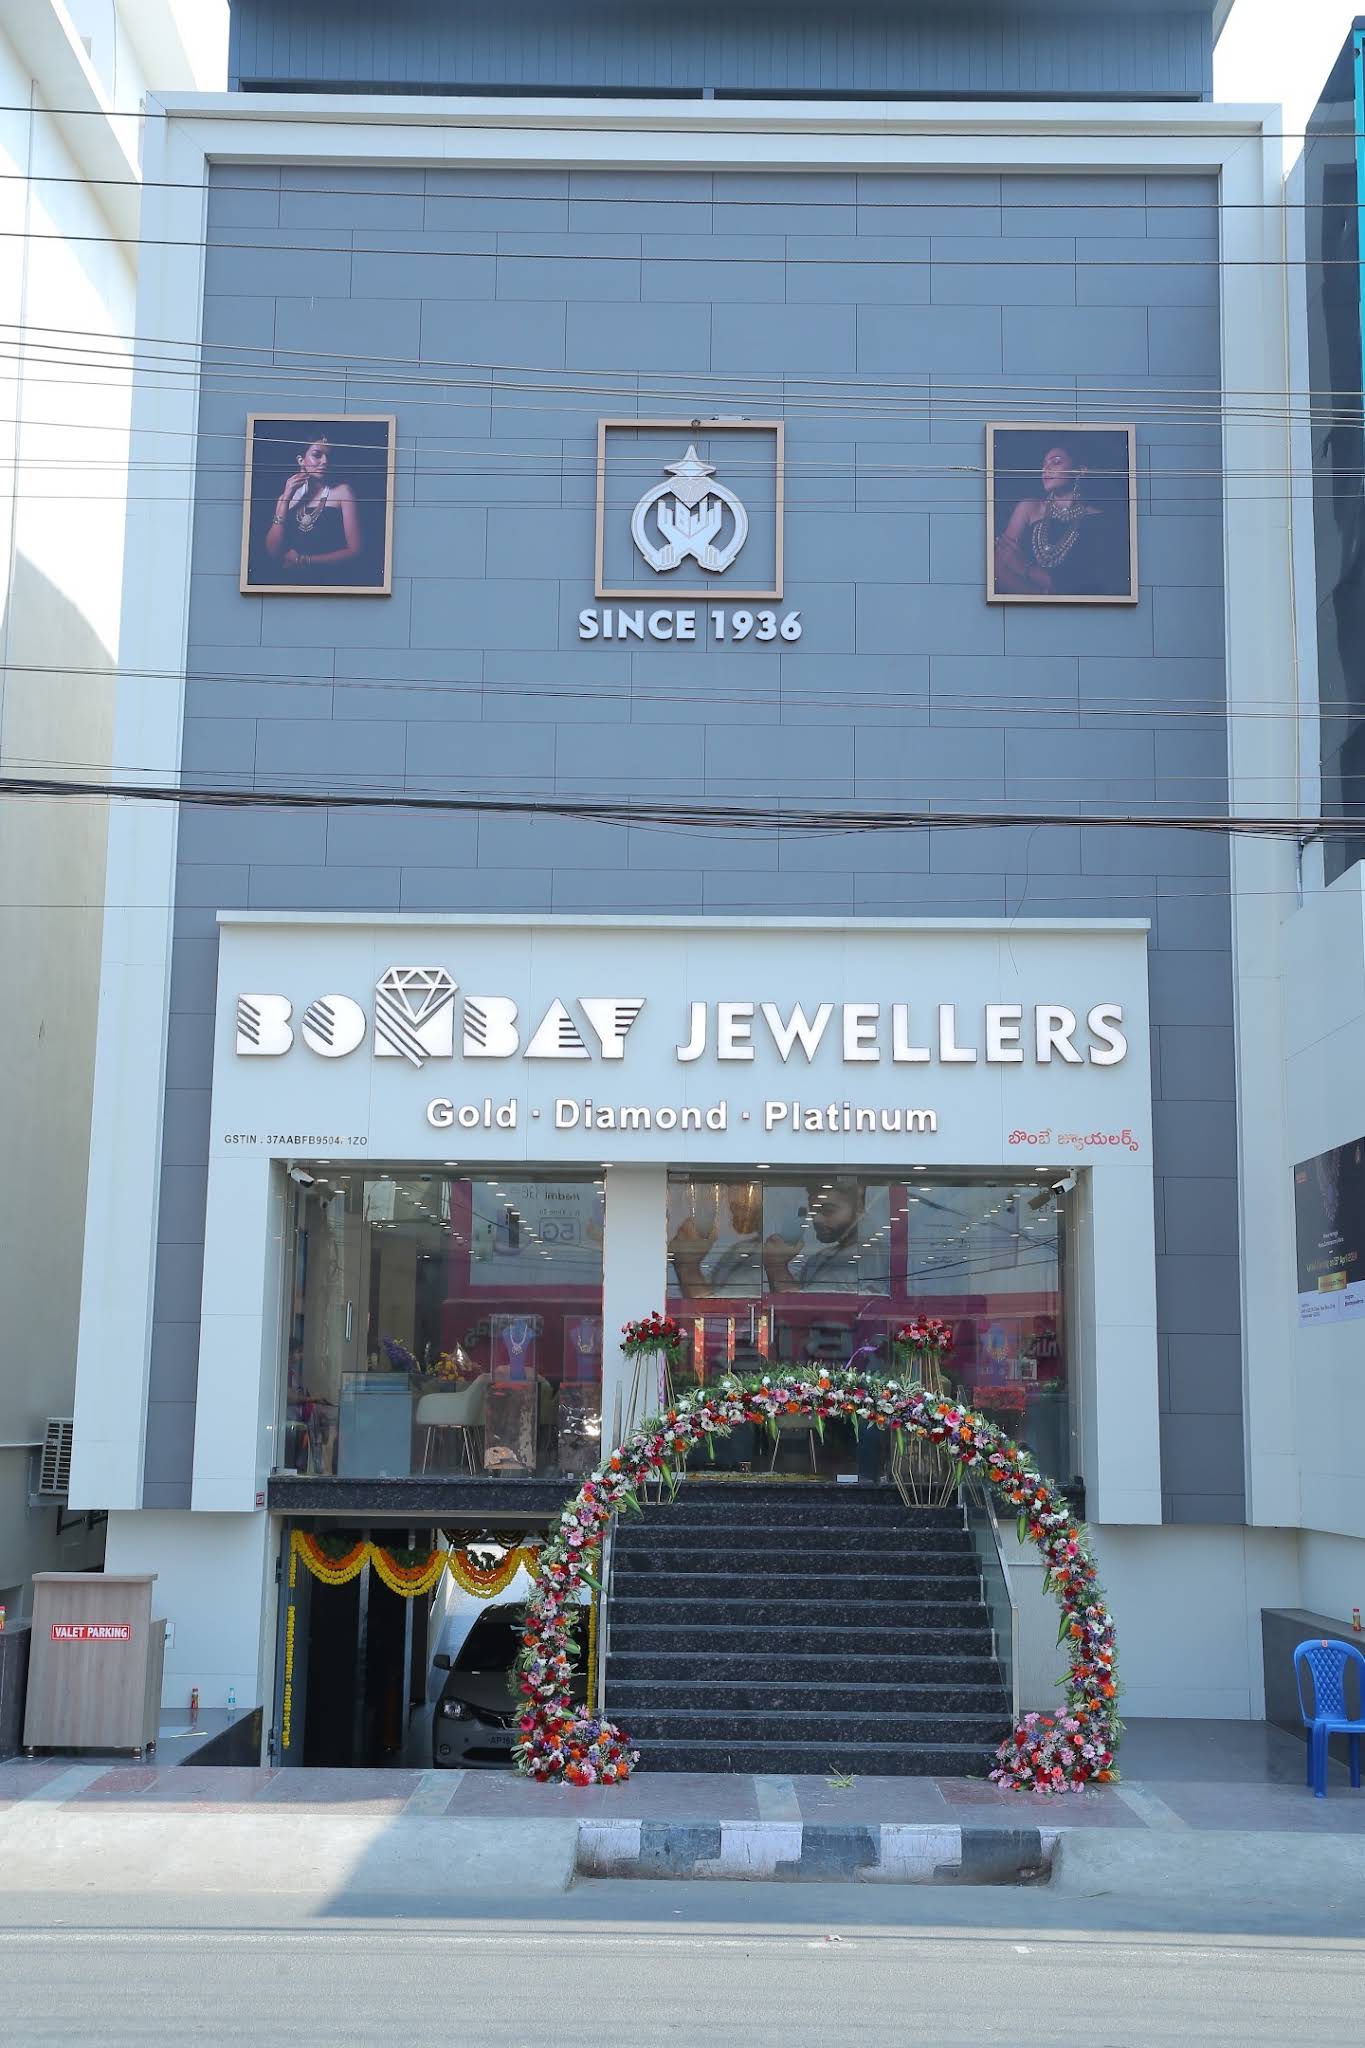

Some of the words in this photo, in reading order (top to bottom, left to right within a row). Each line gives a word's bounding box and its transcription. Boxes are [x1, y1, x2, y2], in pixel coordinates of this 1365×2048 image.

[578, 608, 696, 641] SINCE
[711, 609, 803, 642] 1936
[236, 966, 648, 1068] BOMBAY
[676, 1001, 1129, 1066] JEWELLERS
[426, 1097, 518, 1129] Gold
[554, 1097, 728, 1132] Diamond
[764, 1100, 938, 1133] Platinum
[224, 1134, 257, 1144] GSTIN
[55, 1626, 85, 1638] VALET
[87, 1626, 128, 1638] PARKING
